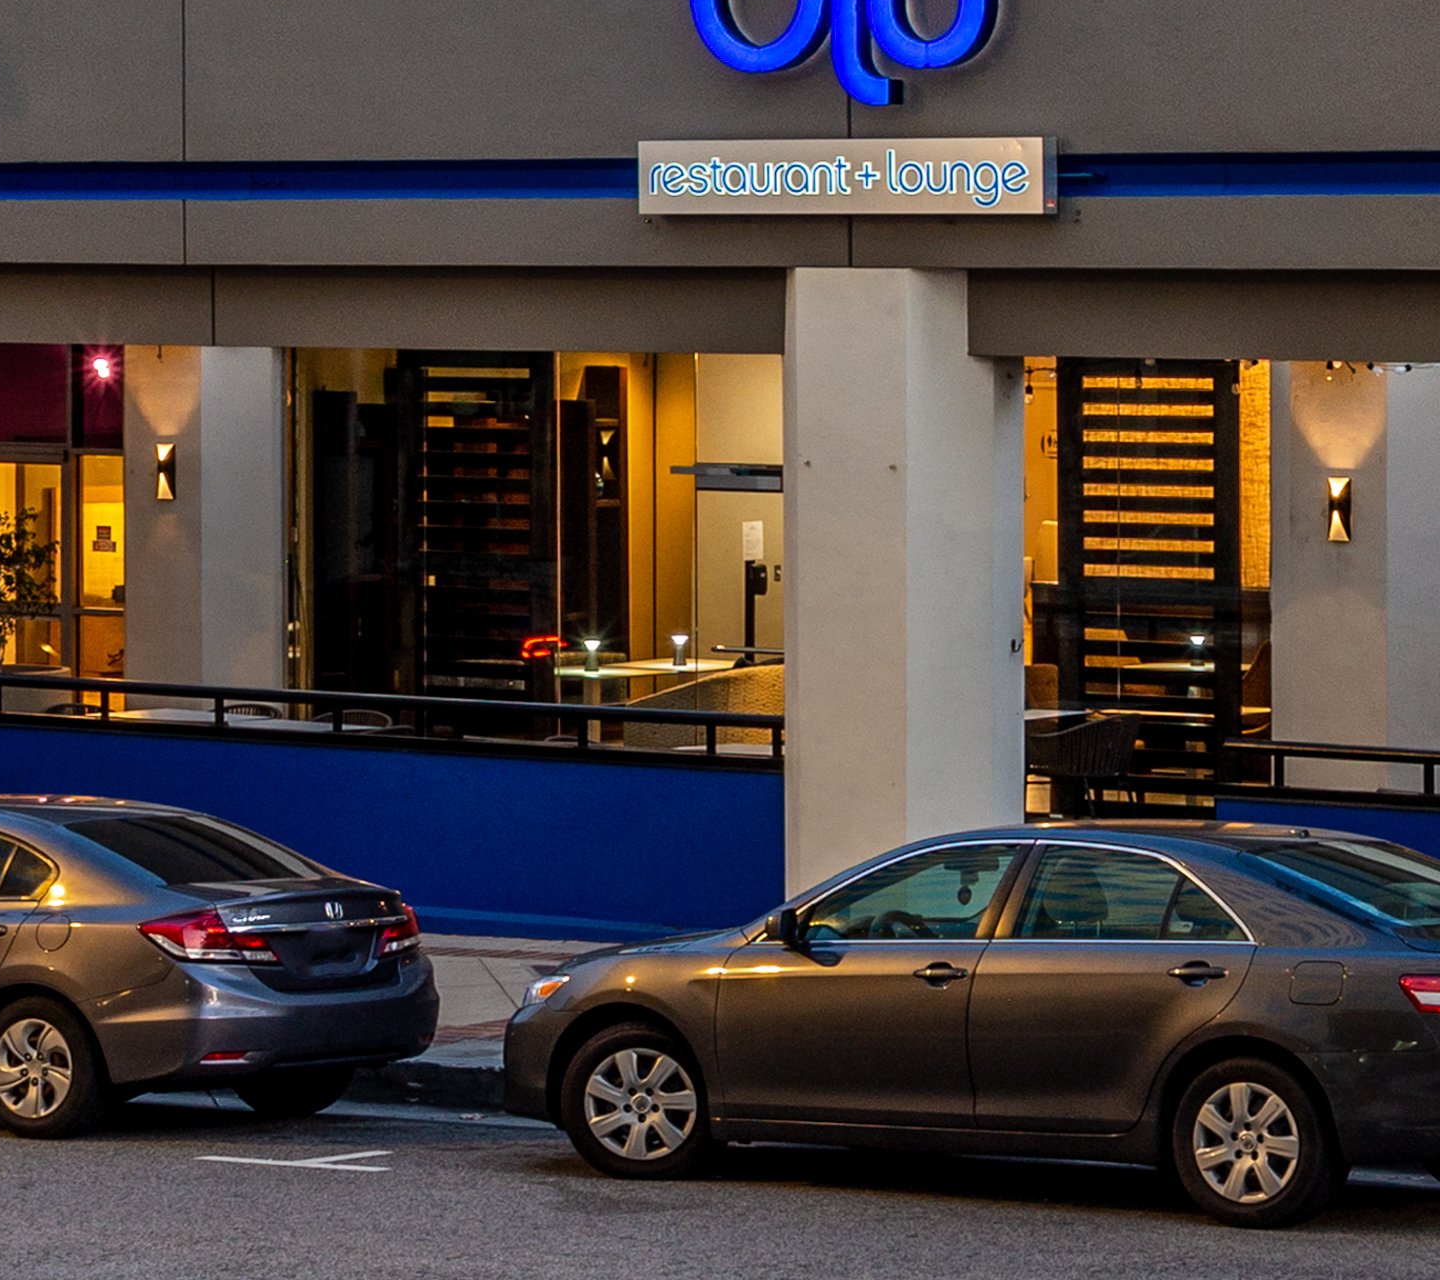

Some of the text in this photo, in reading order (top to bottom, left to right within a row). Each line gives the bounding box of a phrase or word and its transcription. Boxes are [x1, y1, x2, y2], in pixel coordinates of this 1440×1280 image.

[649, 149, 1030, 207] restaurant + lounge
